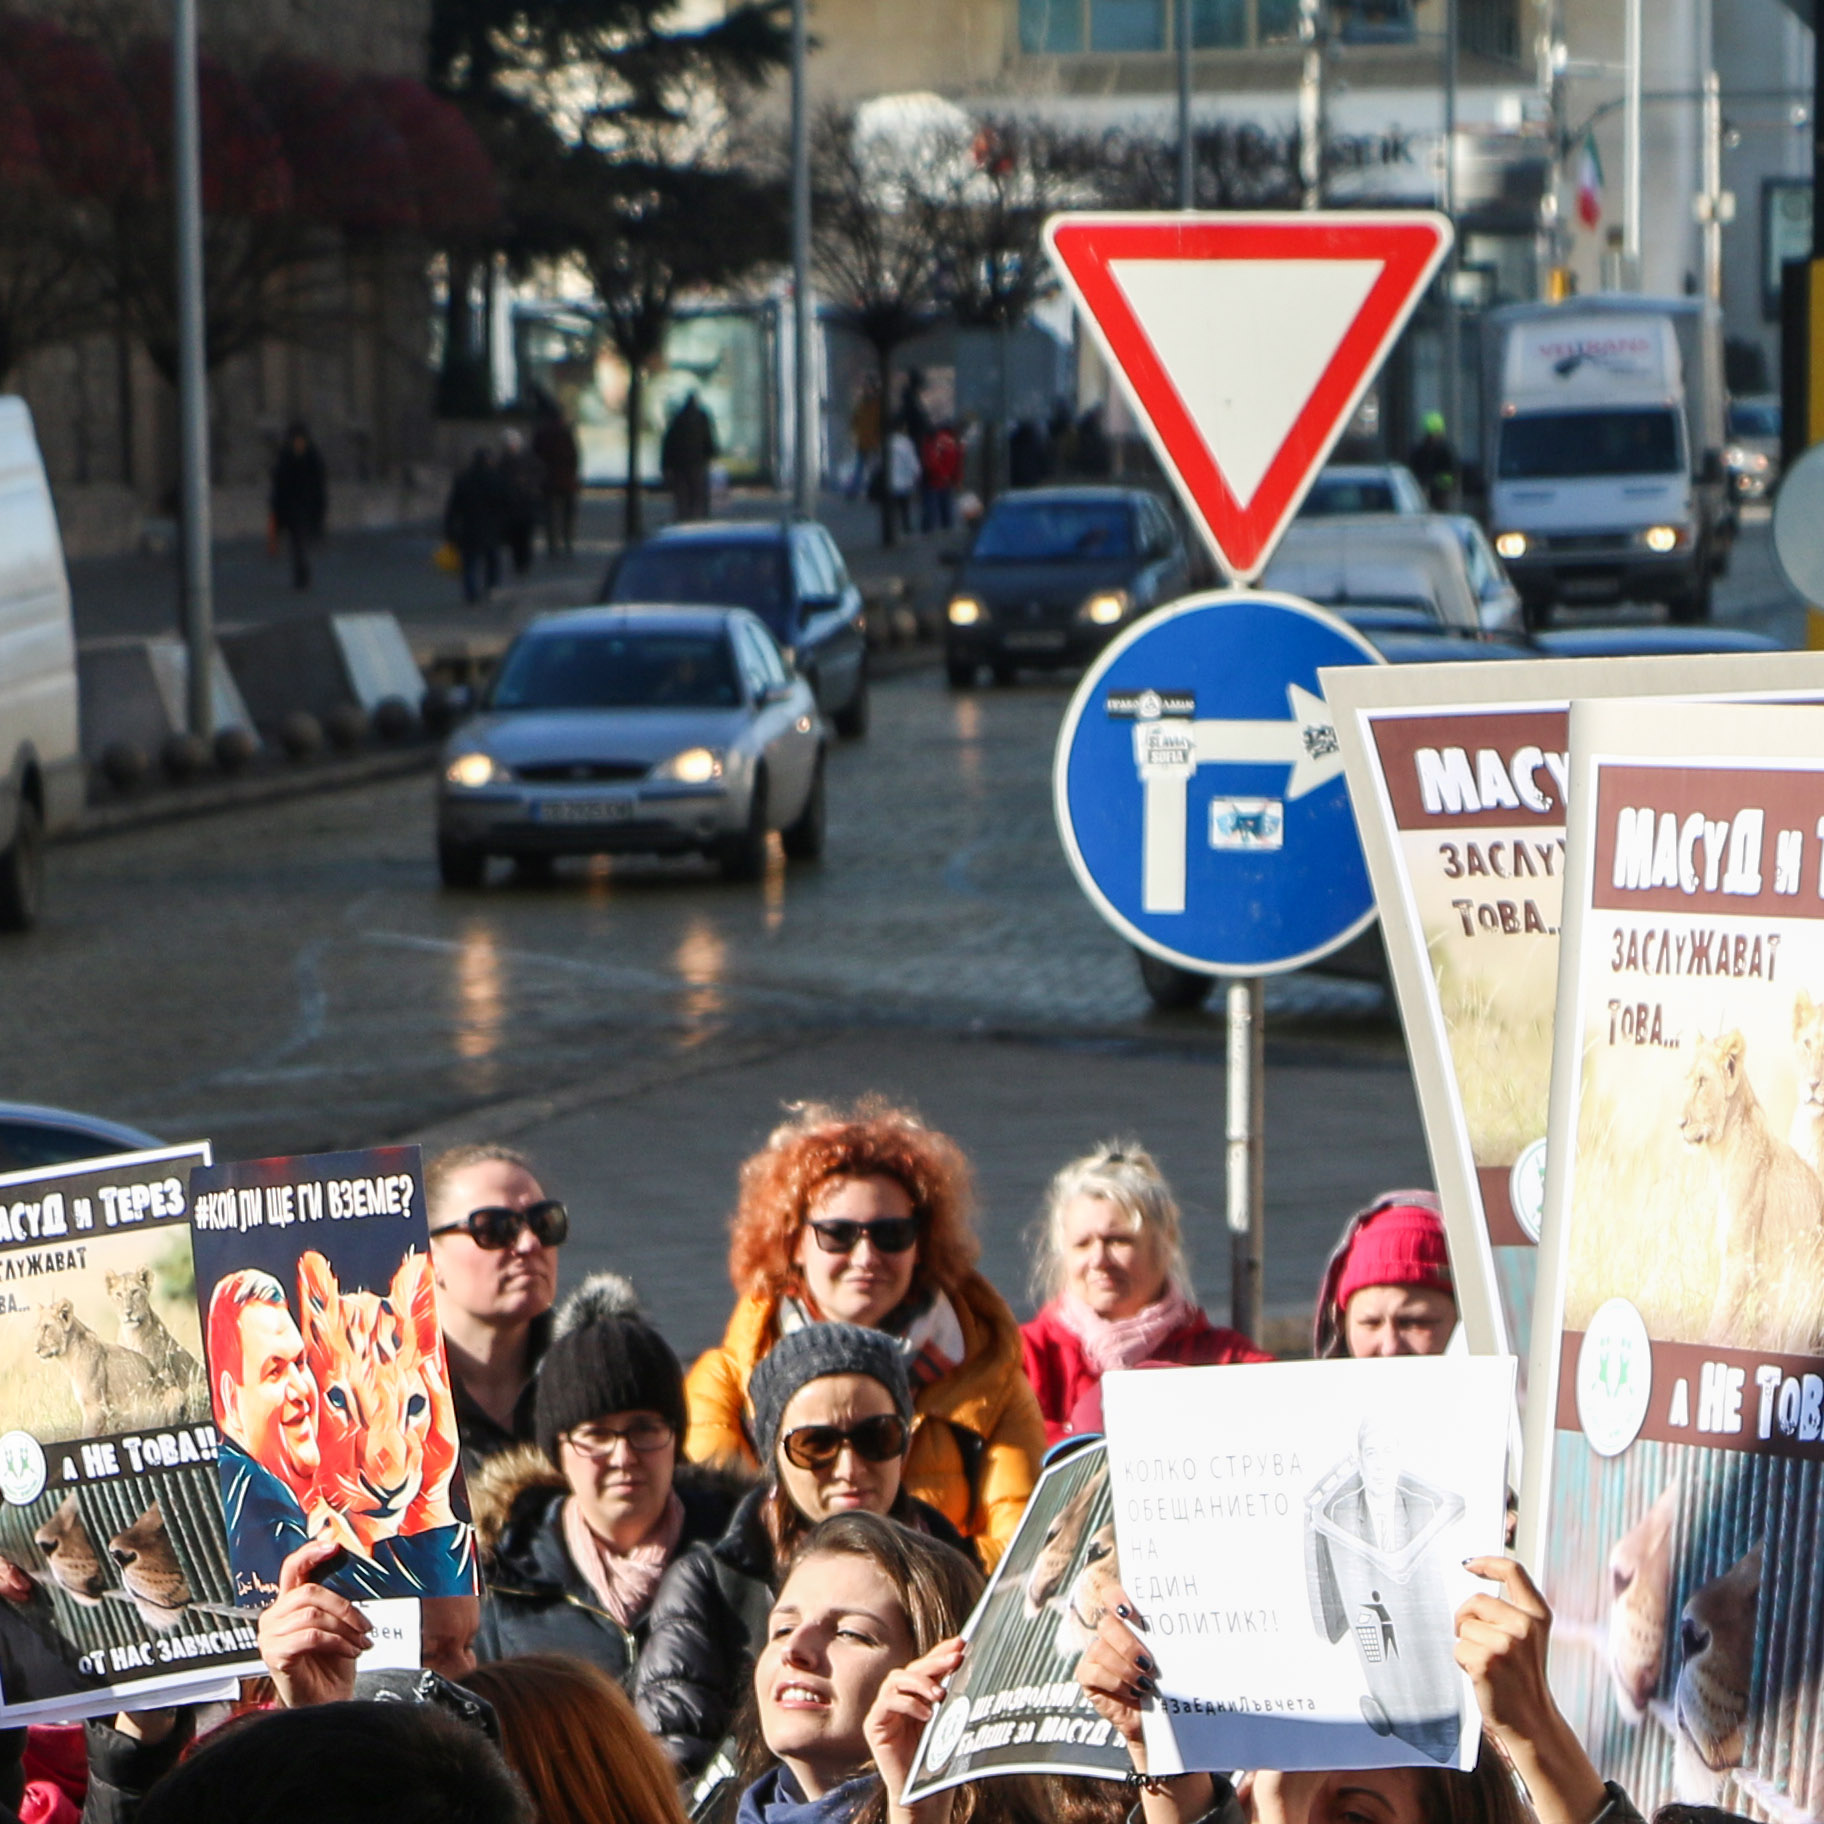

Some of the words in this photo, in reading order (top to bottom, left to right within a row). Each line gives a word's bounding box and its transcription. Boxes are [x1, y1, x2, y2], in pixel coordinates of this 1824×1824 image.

[1612, 806, 1766, 896] МАСУД
[1610, 927, 1782, 982] ЗАСЛУЖАВАТ
[98, 1177, 186, 1228] ТЕРЕЗ
[194, 1187, 238, 1231] #КОЙ
[238, 1186, 264, 1234] ЛИ
[266, 1184, 295, 1229] ЩЕ
[297, 1181, 323, 1223] ГИ
[327, 1173, 415, 1219] ВЗЕМЕ?
[1696, 1360, 1746, 1436] НЕ
[81, 1442, 121, 1480] НЕ
[1125, 1456, 1196, 1482] КОЛКО
[1210, 1452, 1303, 1479] СТРУВА
[1127, 1492, 1289, 1524] ОБЕЩАНИЕТО
[1131, 1537, 1159, 1561] НА
[1134, 1574, 1200, 1602] ЕДИН
[1140, 1609, 1279, 1636] ПОЛИТИК?!
[78, 1650, 106, 1678] ОТ
[110, 1641, 155, 1674] НАС
[1161, 1695, 1316, 1717] #ЗаЕдниЛъвчета
[1035, 1715, 1113, 1747] МАСУД
